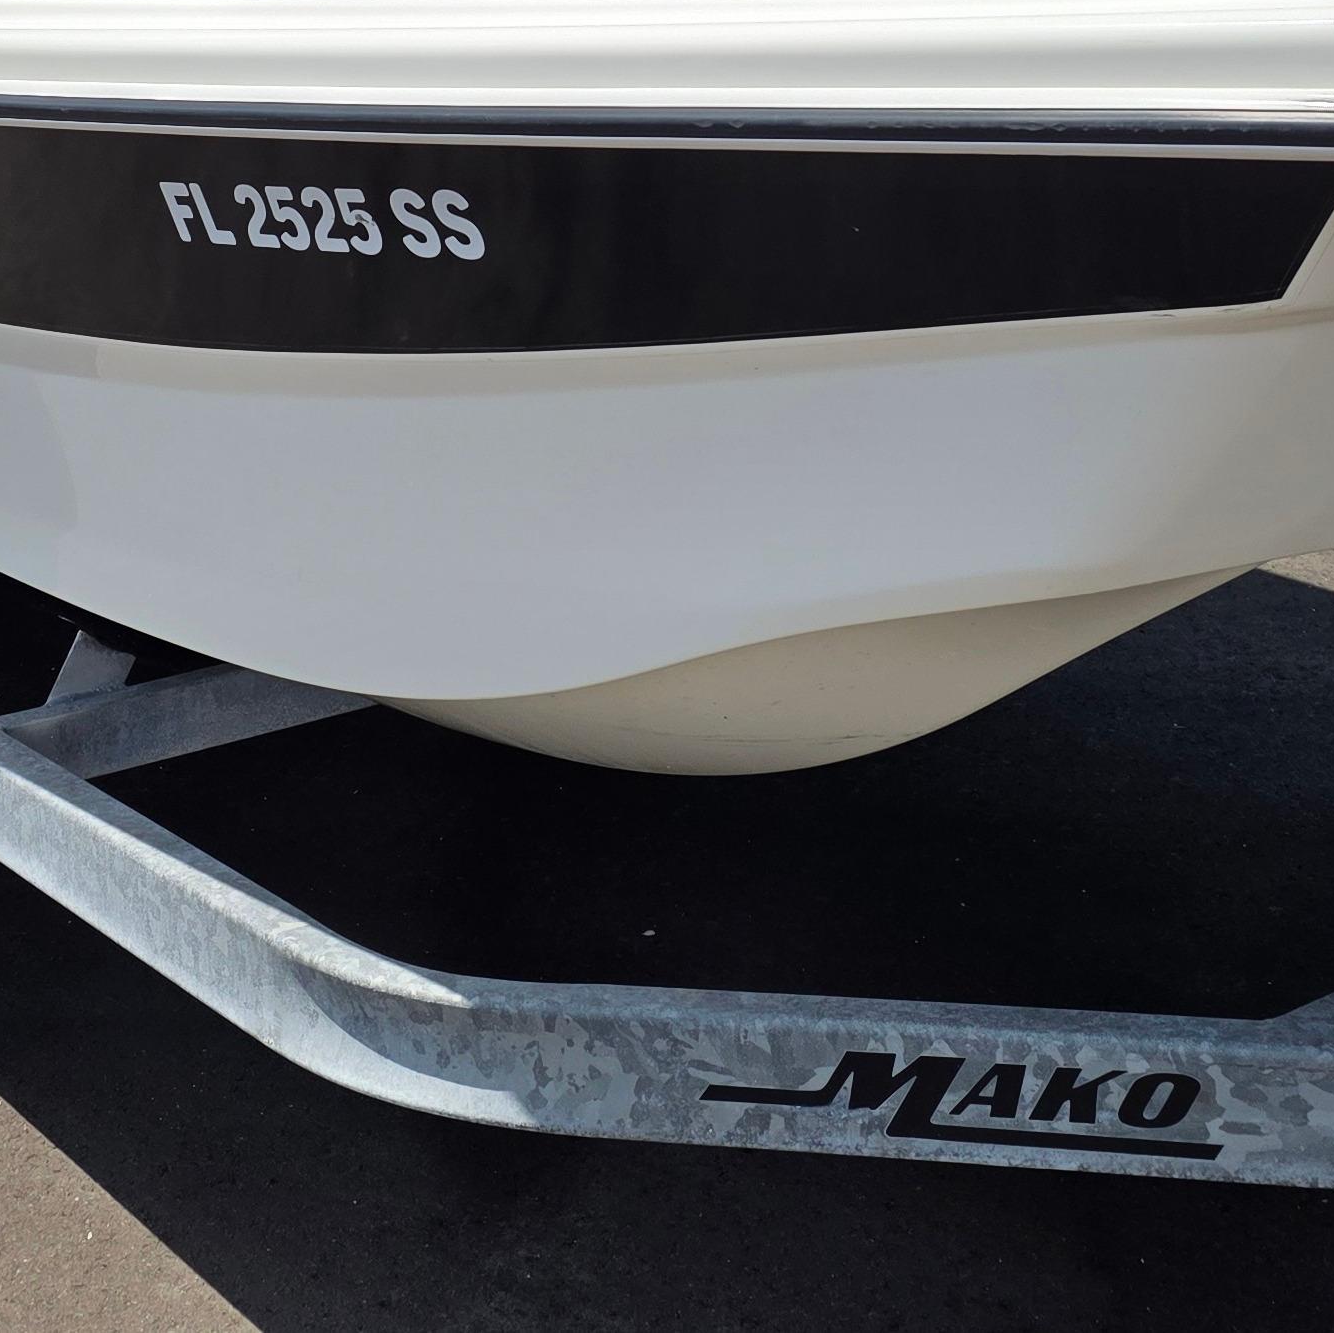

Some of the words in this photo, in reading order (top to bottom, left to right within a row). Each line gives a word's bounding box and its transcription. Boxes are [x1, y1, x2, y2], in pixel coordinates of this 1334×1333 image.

[159, 181, 237, 246] FL
[233, 183, 383, 256] 2525
[389, 188, 486, 261] SS
[699, 1051, 1224, 1161] MAKO
